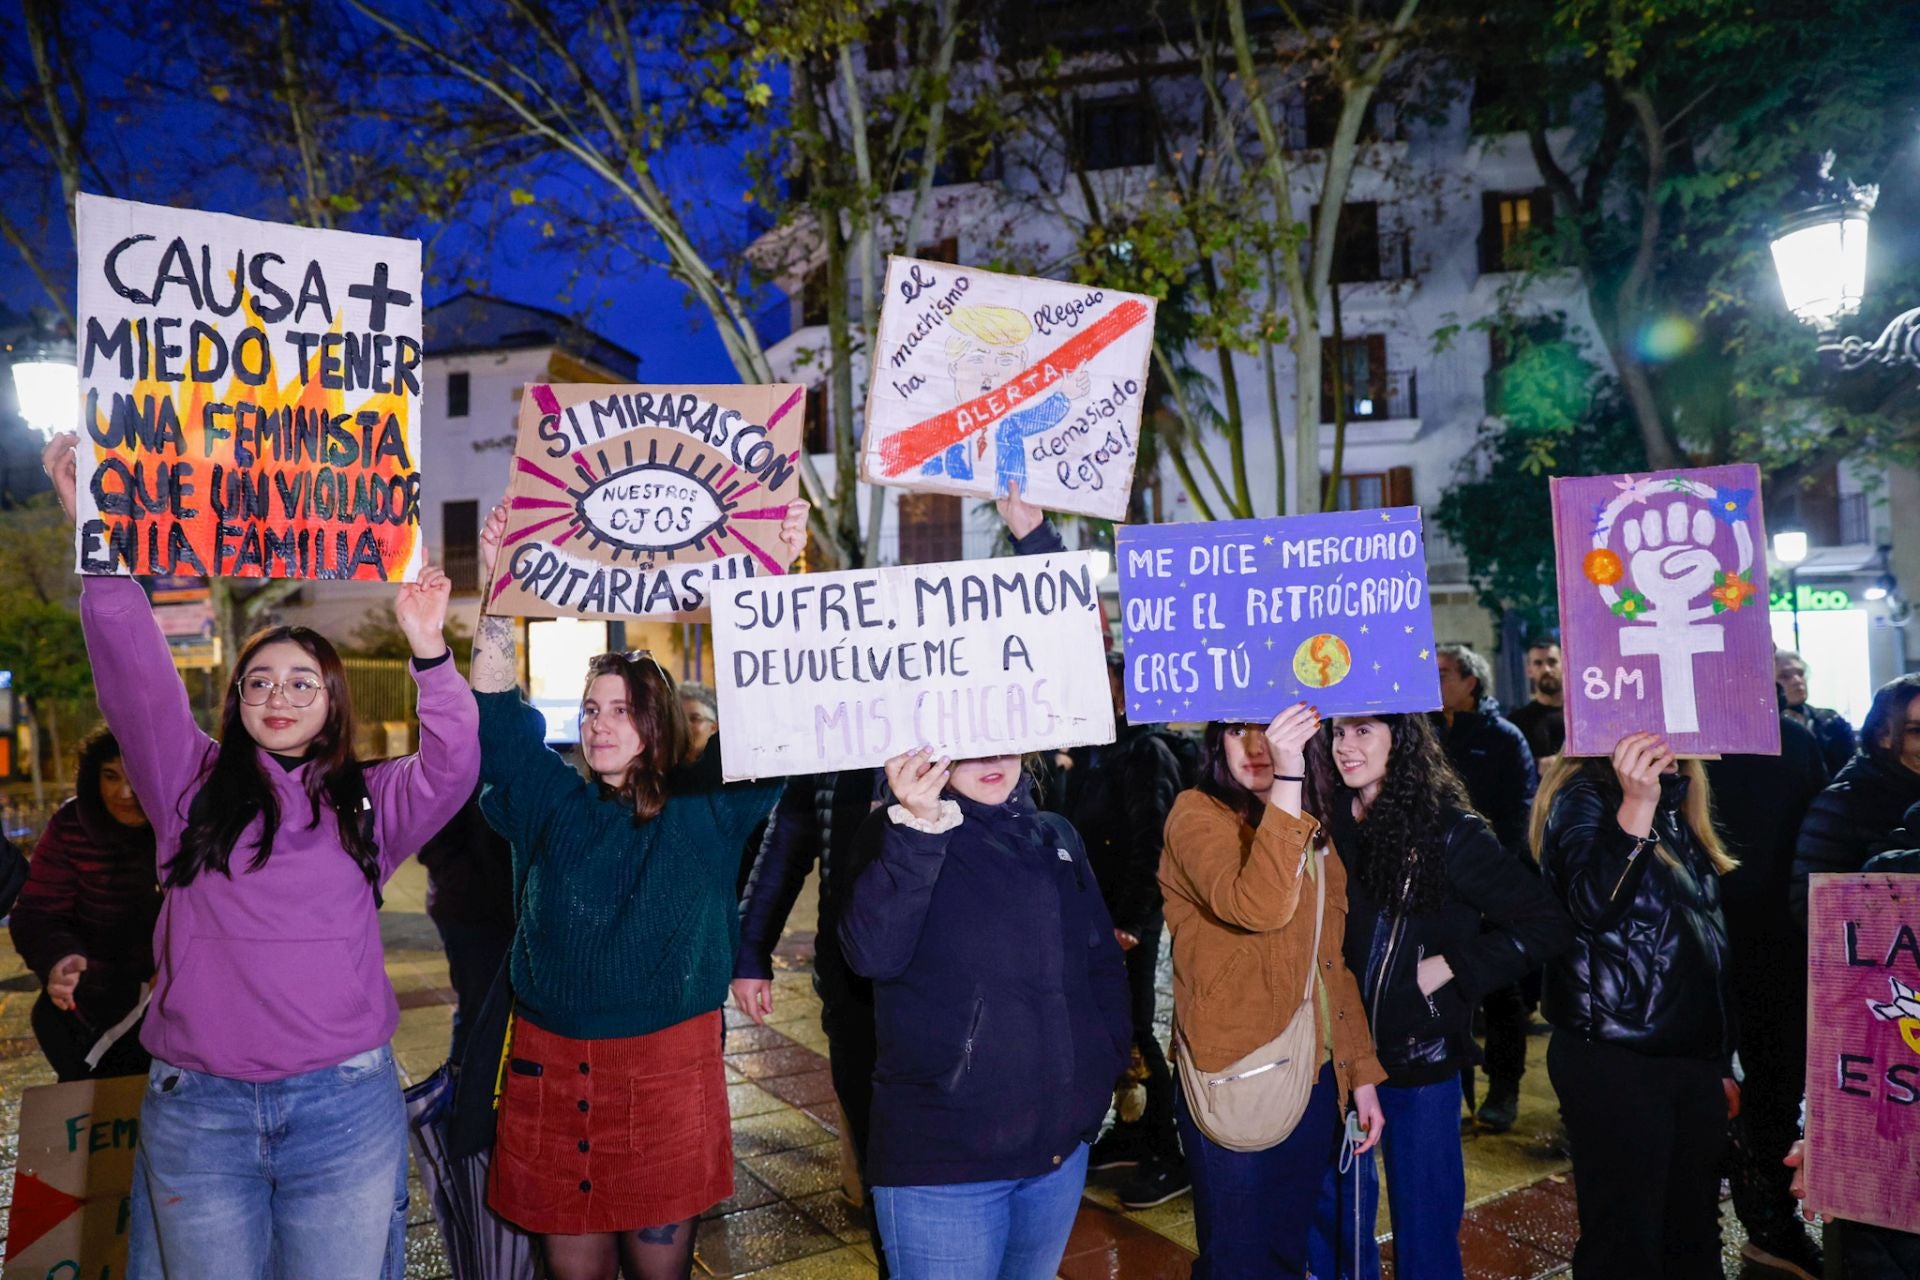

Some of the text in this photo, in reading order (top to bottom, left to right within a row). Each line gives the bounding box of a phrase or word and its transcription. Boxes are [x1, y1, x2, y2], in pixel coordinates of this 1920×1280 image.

[104, 234, 412, 331] CAUSA +
[900, 264, 936, 304] el
[891, 276, 970, 368] machismo
[1034, 291, 1104, 335] llegado
[83, 317, 421, 396] MIEDO TENER
[892, 373, 926, 400] ha
[956, 363, 1061, 433] ALERTA
[85, 387, 410, 468] UNA FEMINISTA
[538, 392, 795, 491] SI MIRARAS CON
[1032, 379, 1138, 462] demasiado
[90, 457, 421, 526] QUE UN VIOLADOR
[602, 484, 698, 502] NUESTROS
[609, 507, 693, 532] OJOS
[81, 519, 388, 581] EN LA FAMILIA
[1128, 529, 1417, 578] ME DICE MERCURIO
[1126, 596, 1176, 632] QUE
[1192, 592, 1225, 630] EL
[1003, 635, 1034, 672] A
[1133, 641, 1251, 693] ERES TÚ
[1582, 665, 1645, 701] 8M
[815, 679, 1057, 760] MIS CHICAS
